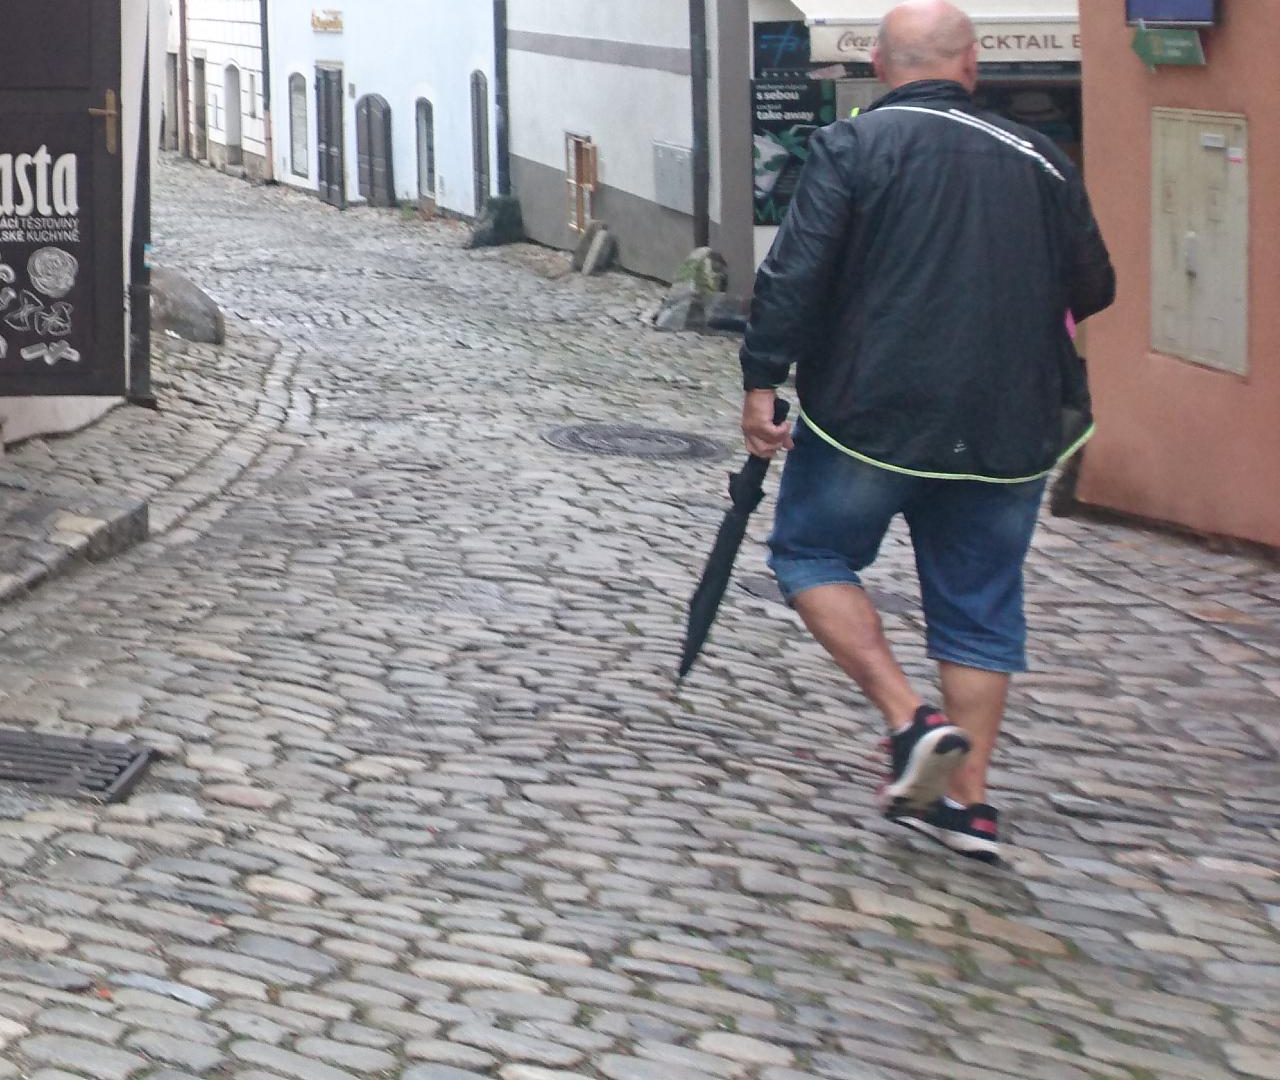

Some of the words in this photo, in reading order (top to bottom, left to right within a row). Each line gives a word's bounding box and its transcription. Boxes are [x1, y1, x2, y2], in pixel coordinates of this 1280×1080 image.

[980, 34, 1064, 49] CKTAIL
[756, 110, 782, 120] take
[783, 111, 815, 121] away
